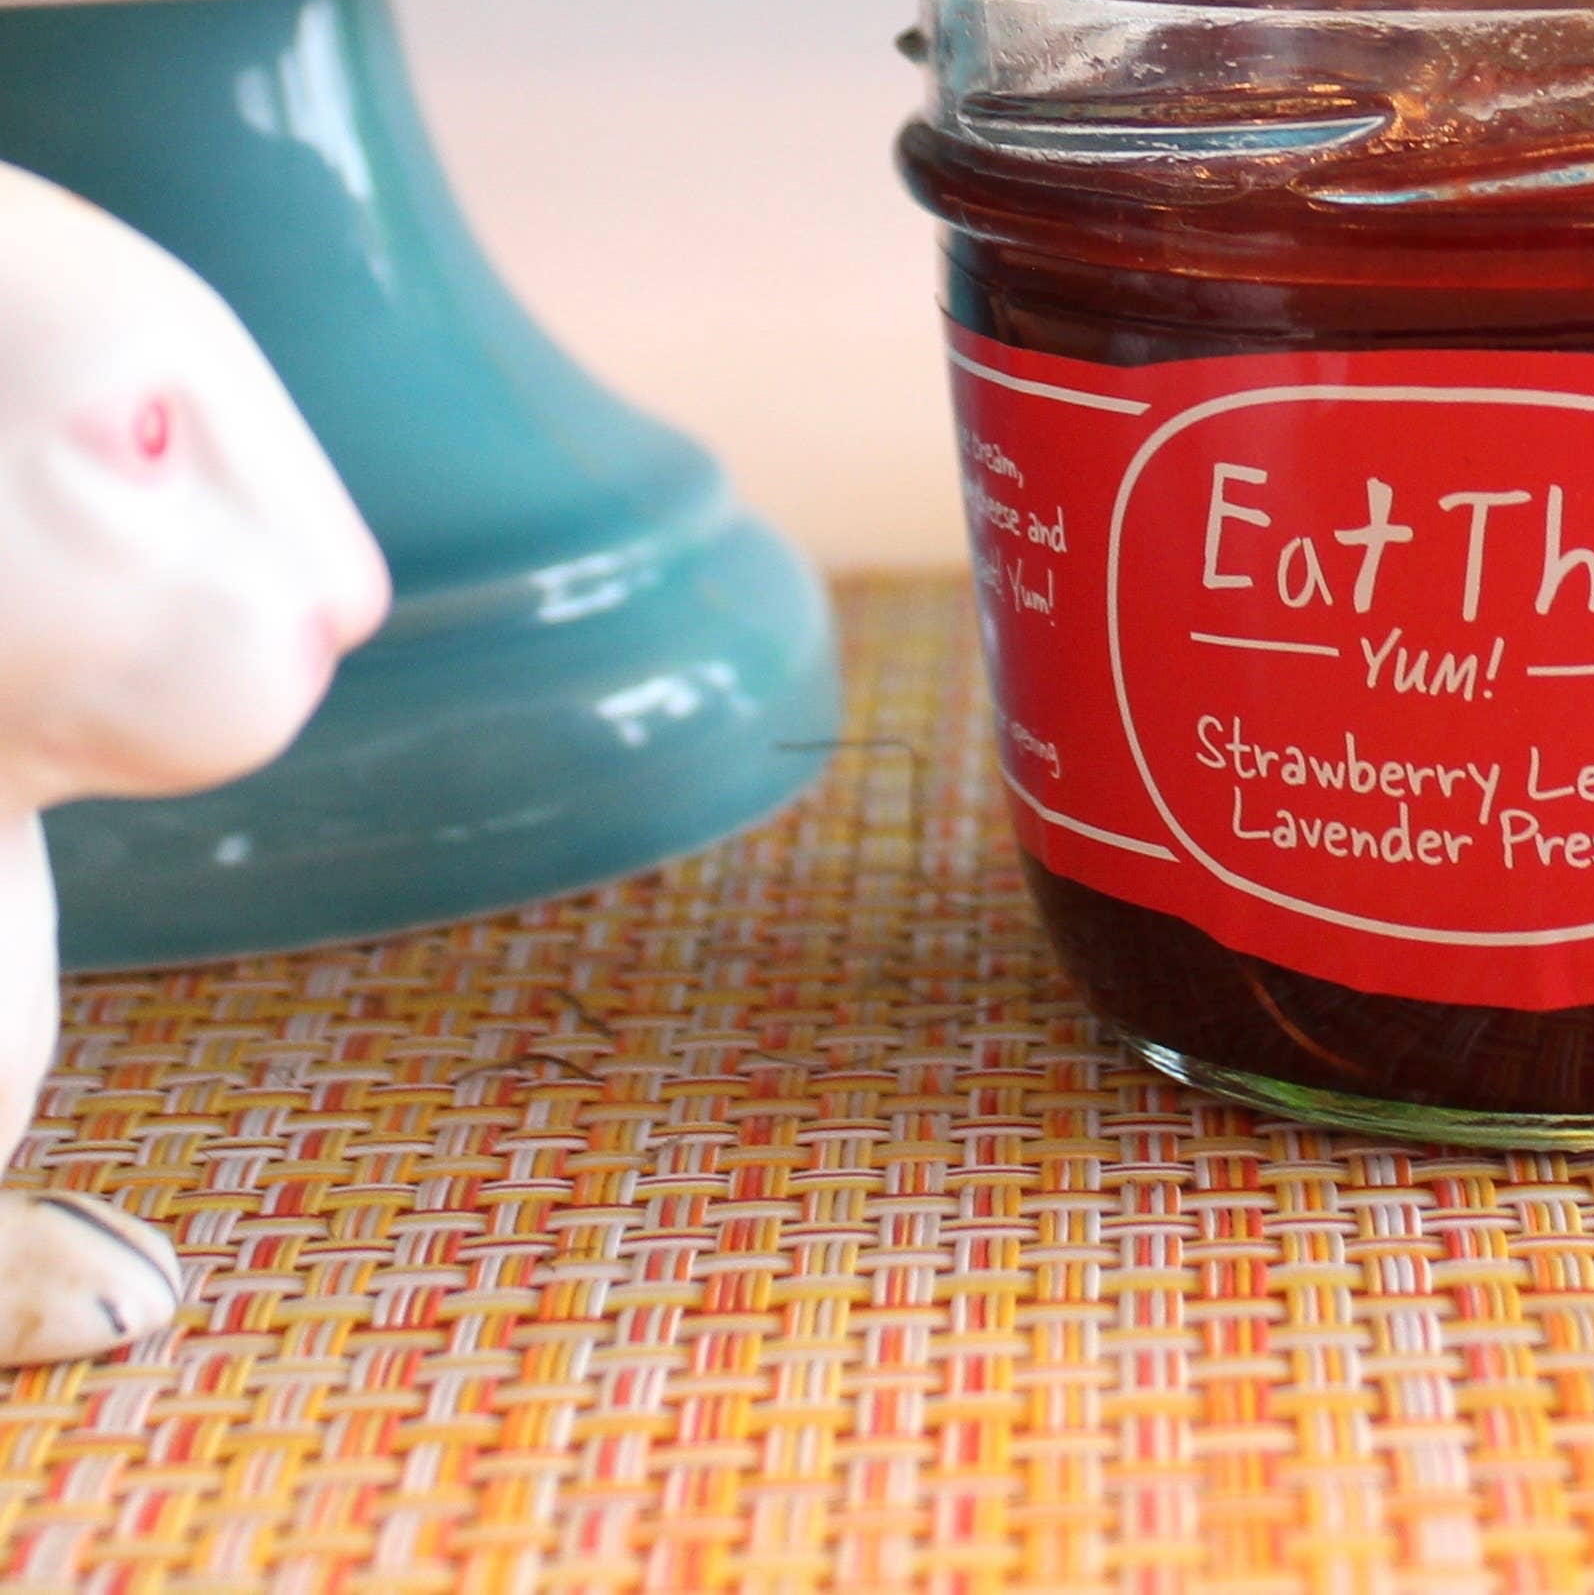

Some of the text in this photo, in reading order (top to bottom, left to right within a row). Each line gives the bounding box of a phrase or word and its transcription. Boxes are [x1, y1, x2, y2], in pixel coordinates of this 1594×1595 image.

[1027, 505, 1068, 553] and
[1202, 462, 1414, 614] Eat
[1005, 557, 1056, 628] Yum!
[1196, 715, 1500, 825] Strawberry
[1232, 786, 1473, 865] Lavender
